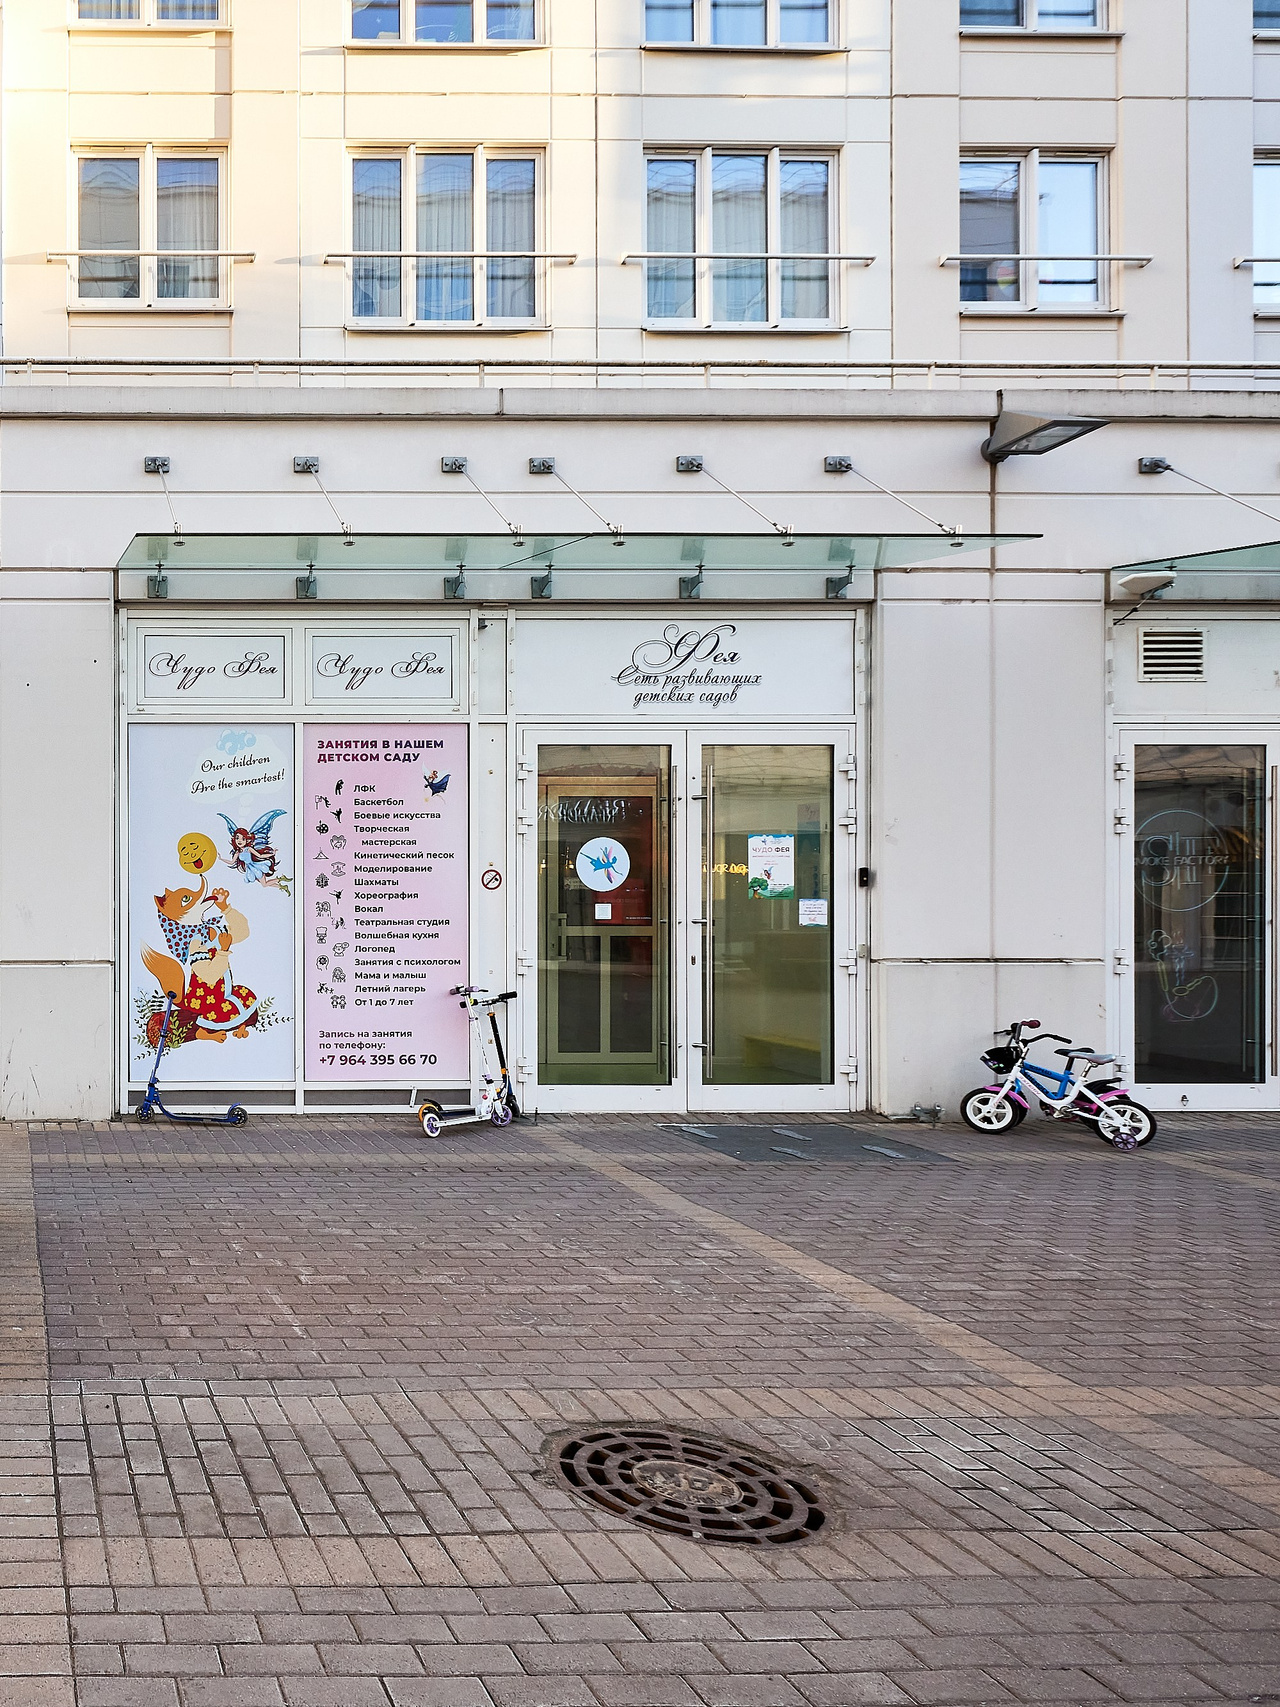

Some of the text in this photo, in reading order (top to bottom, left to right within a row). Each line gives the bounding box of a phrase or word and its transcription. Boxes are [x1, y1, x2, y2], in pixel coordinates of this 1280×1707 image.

[149, 652, 278, 690] Чудо Фея
[317, 652, 445, 690] Чудо Фея
[611, 664, 762, 689] Сеть развивающих
[633, 685, 739, 708] детских садов
[318, 740, 443, 748] ЗАНЯТИЯ В НАШЕМ
[201, 754, 270, 773] Our children
[318, 753, 420, 763] ДЕТСКОМ САДУ
[191, 769, 285, 794] Are the smartest!
[354, 866, 432, 874] Моделирование
[354, 892, 418, 900] Хореография
[354, 919, 414, 927] Театральная
[334, 1042, 385, 1050] телефону:
[320, 1054, 436, 1065] +7 964 395 66 70
